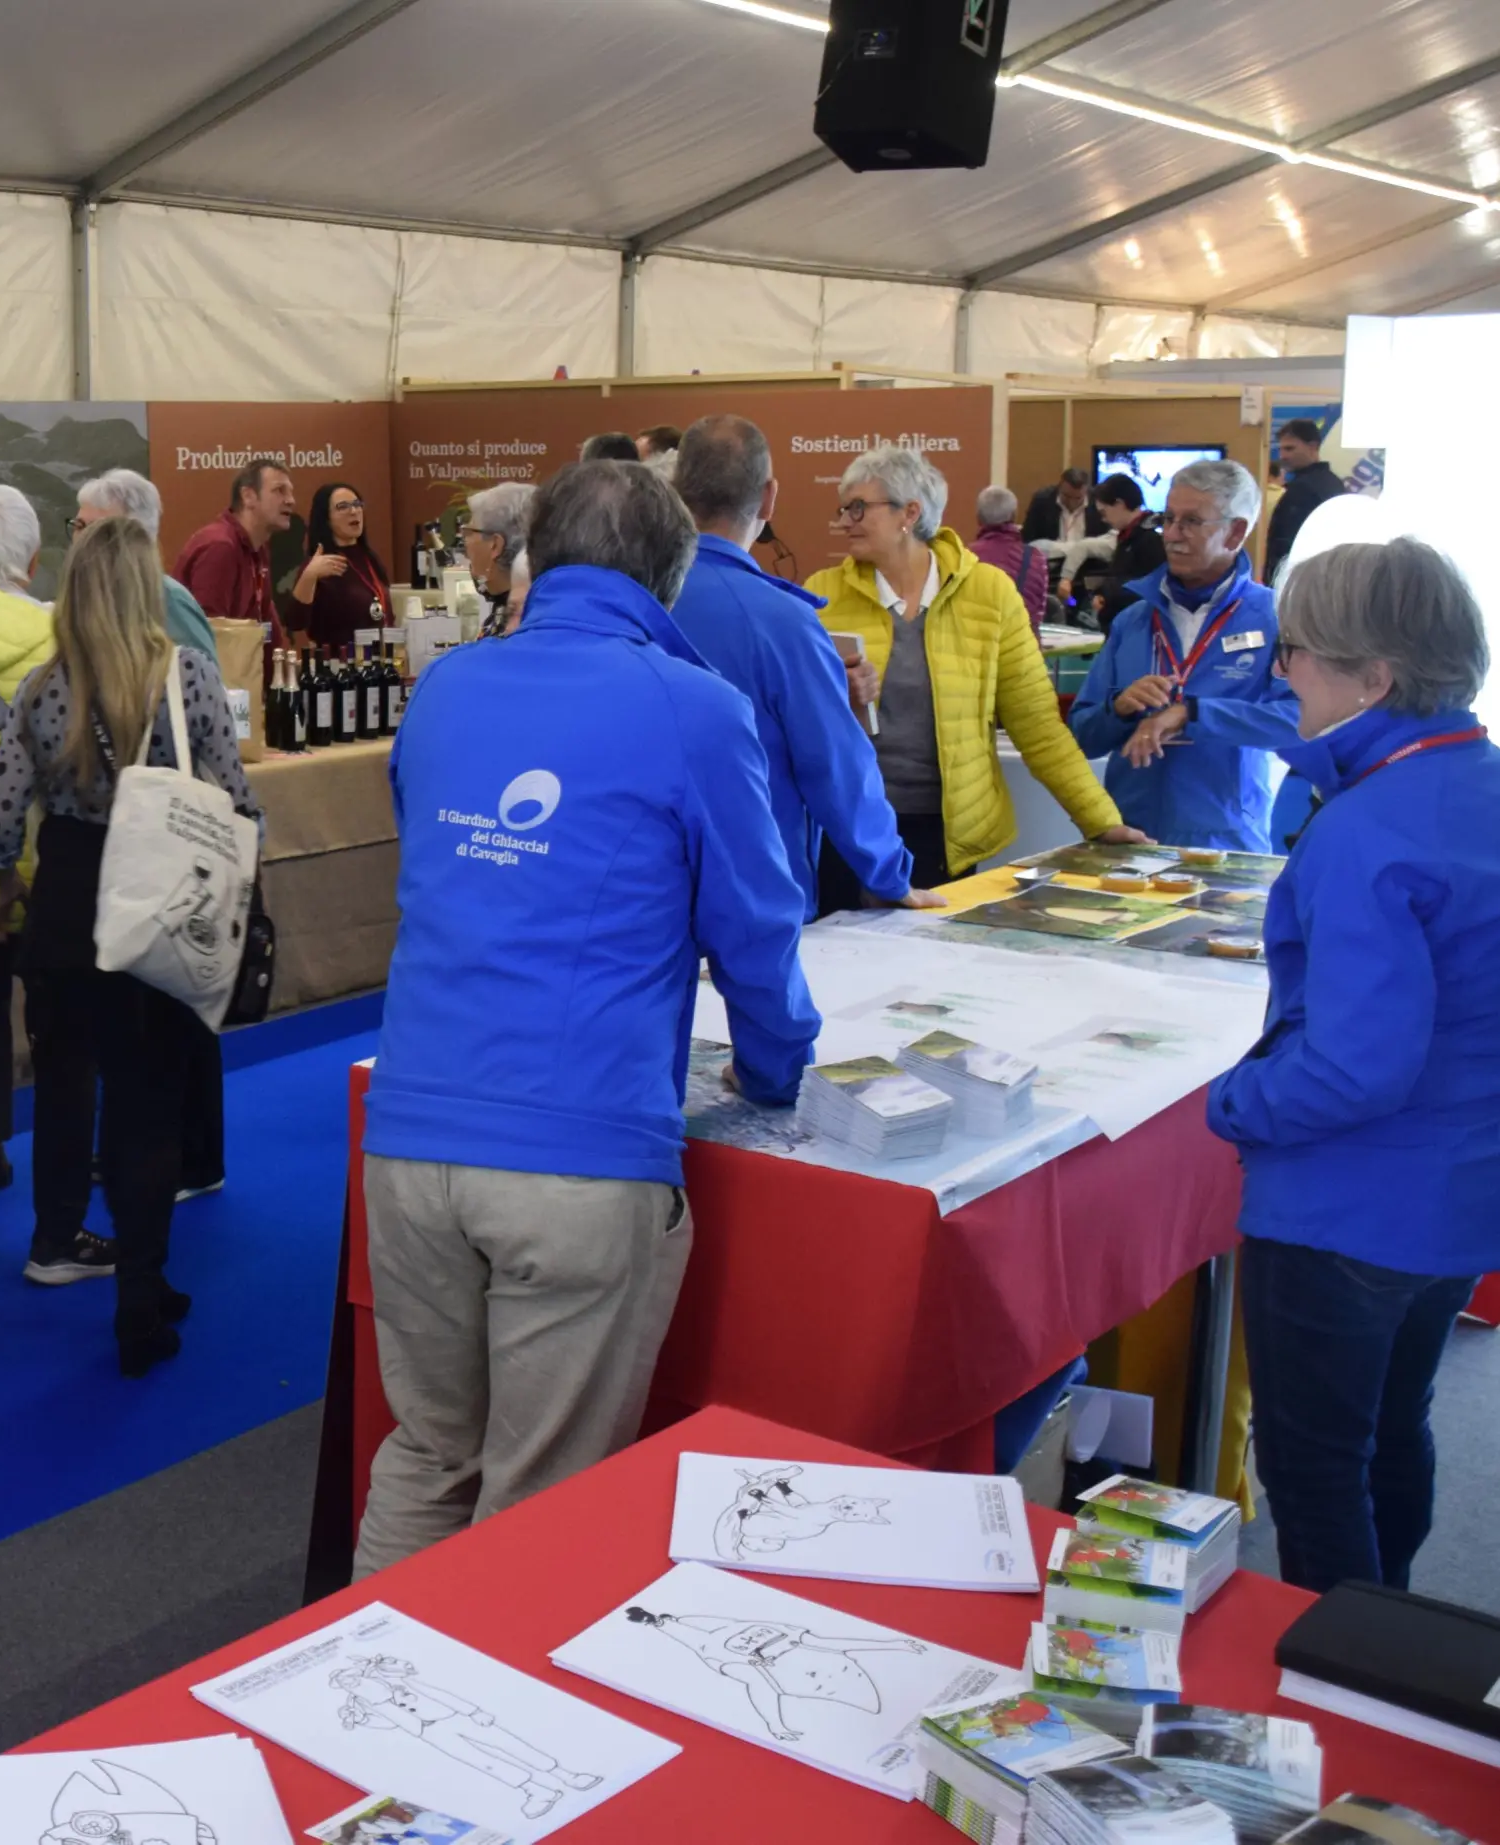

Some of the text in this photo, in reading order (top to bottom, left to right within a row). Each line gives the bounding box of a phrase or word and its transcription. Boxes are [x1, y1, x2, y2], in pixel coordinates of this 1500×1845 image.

[409, 438, 547, 459] Quanto si produce
[791, 433, 869, 453] Sostieni
[288, 443, 343, 468] locale
[409, 461, 536, 481] in Valposchiavo?
[438, 808, 497, 830] Il Giardino
[471, 829, 549, 855] dei Ghiacciai
[456, 842, 518, 866] di Cavaglia
